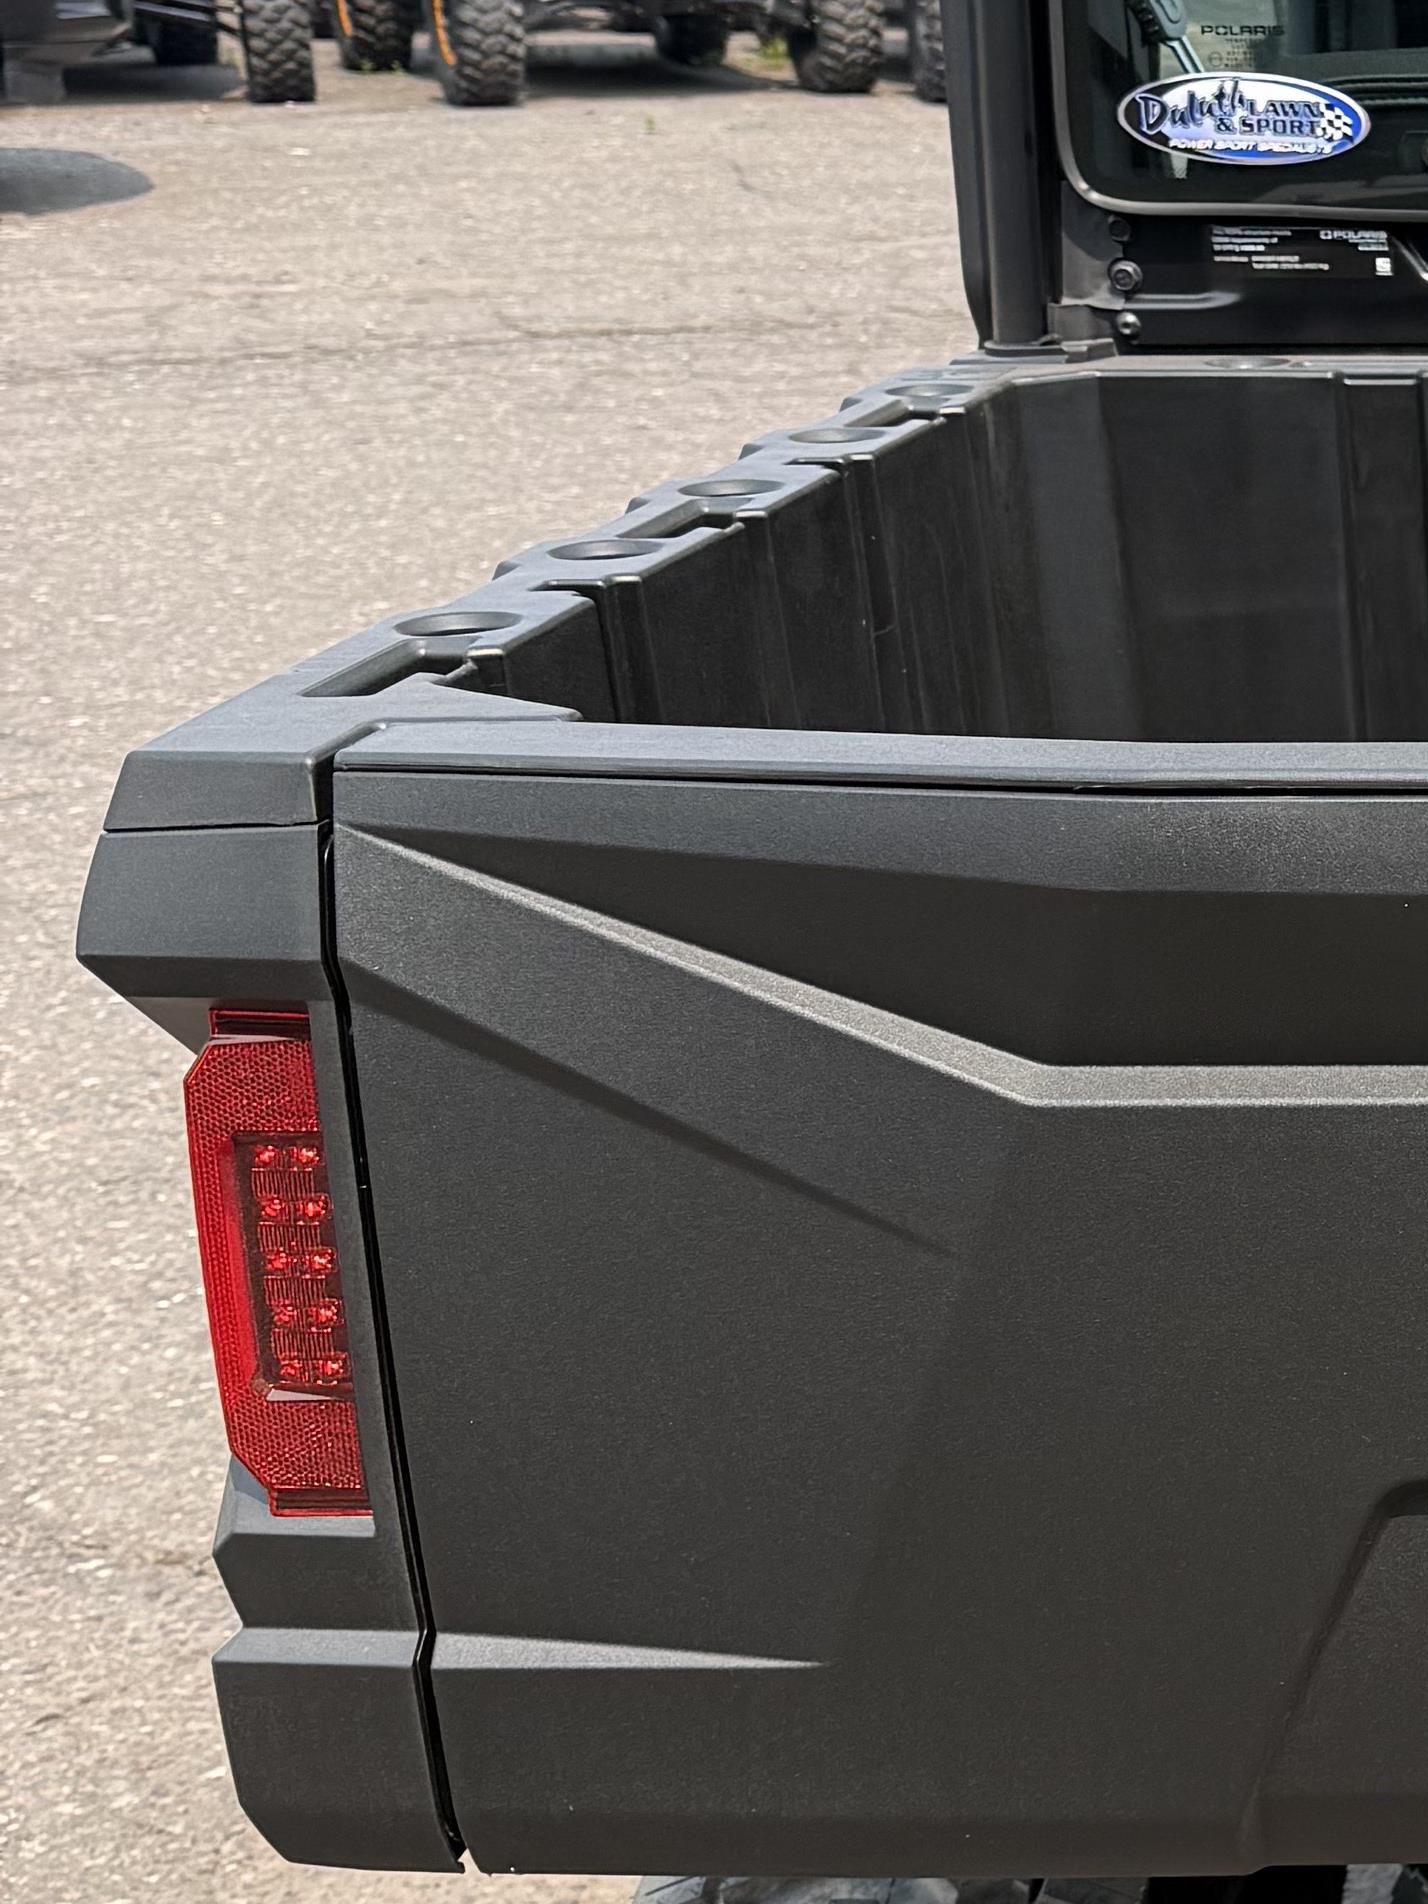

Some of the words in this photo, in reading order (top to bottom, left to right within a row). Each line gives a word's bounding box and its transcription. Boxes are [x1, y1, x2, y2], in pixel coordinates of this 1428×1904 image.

[1201, 25, 1284, 36] POLARIS
[1134, 77, 1248, 135] Duluth
[1249, 100, 1321, 118] LAWN
[1216, 117, 1236, 134] &
[1241, 118, 1321, 136] SPORT
[1169, 139, 1213, 151] POWER
[1214, 141, 1256, 151] SPORT
